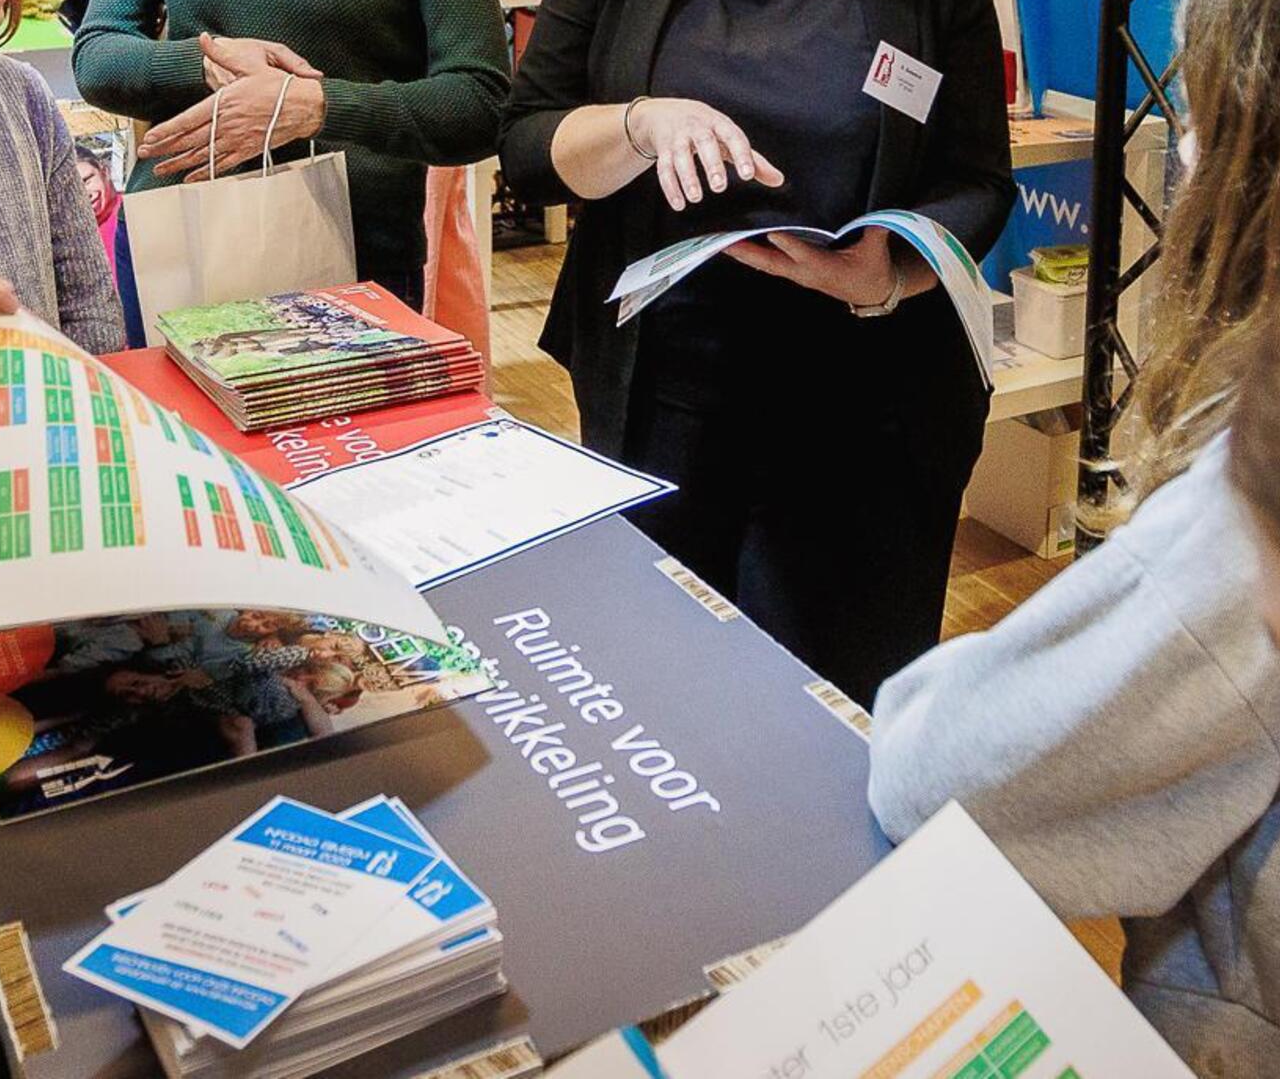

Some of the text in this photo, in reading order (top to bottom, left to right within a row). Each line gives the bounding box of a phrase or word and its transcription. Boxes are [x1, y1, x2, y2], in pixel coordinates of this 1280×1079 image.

[492, 607, 721, 813] Ruimte voor
[818, 990, 881, 1046] 1ste
[880, 939, 934, 1007] jaar
